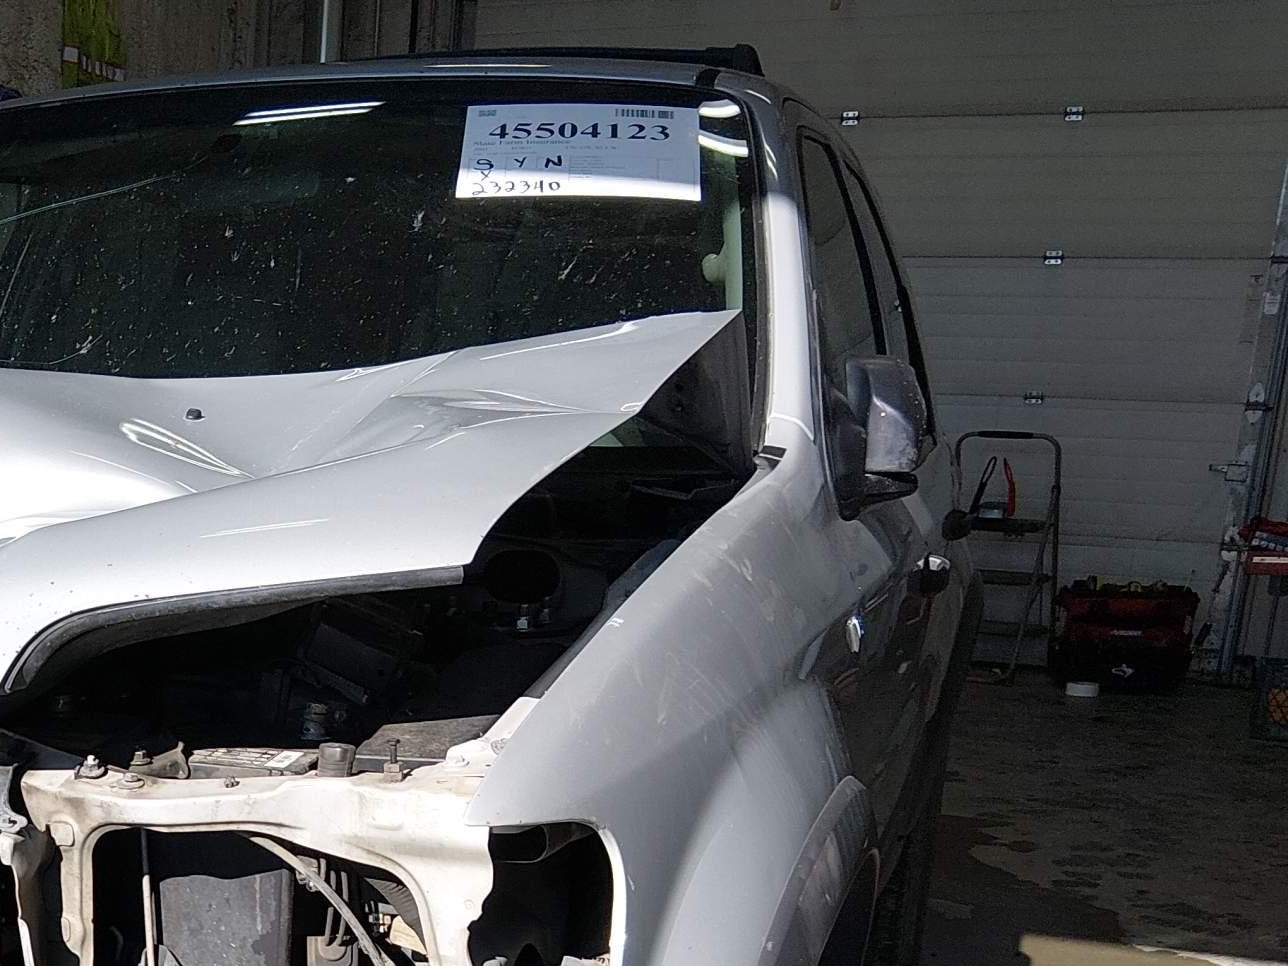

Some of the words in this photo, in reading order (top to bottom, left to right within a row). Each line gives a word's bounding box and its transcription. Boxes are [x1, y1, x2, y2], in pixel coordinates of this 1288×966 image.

[488, 121, 671, 141] 45504123
[514, 156, 527, 168] Y
[544, 155, 562, 168] N
[472, 180, 561, 196] 232340
